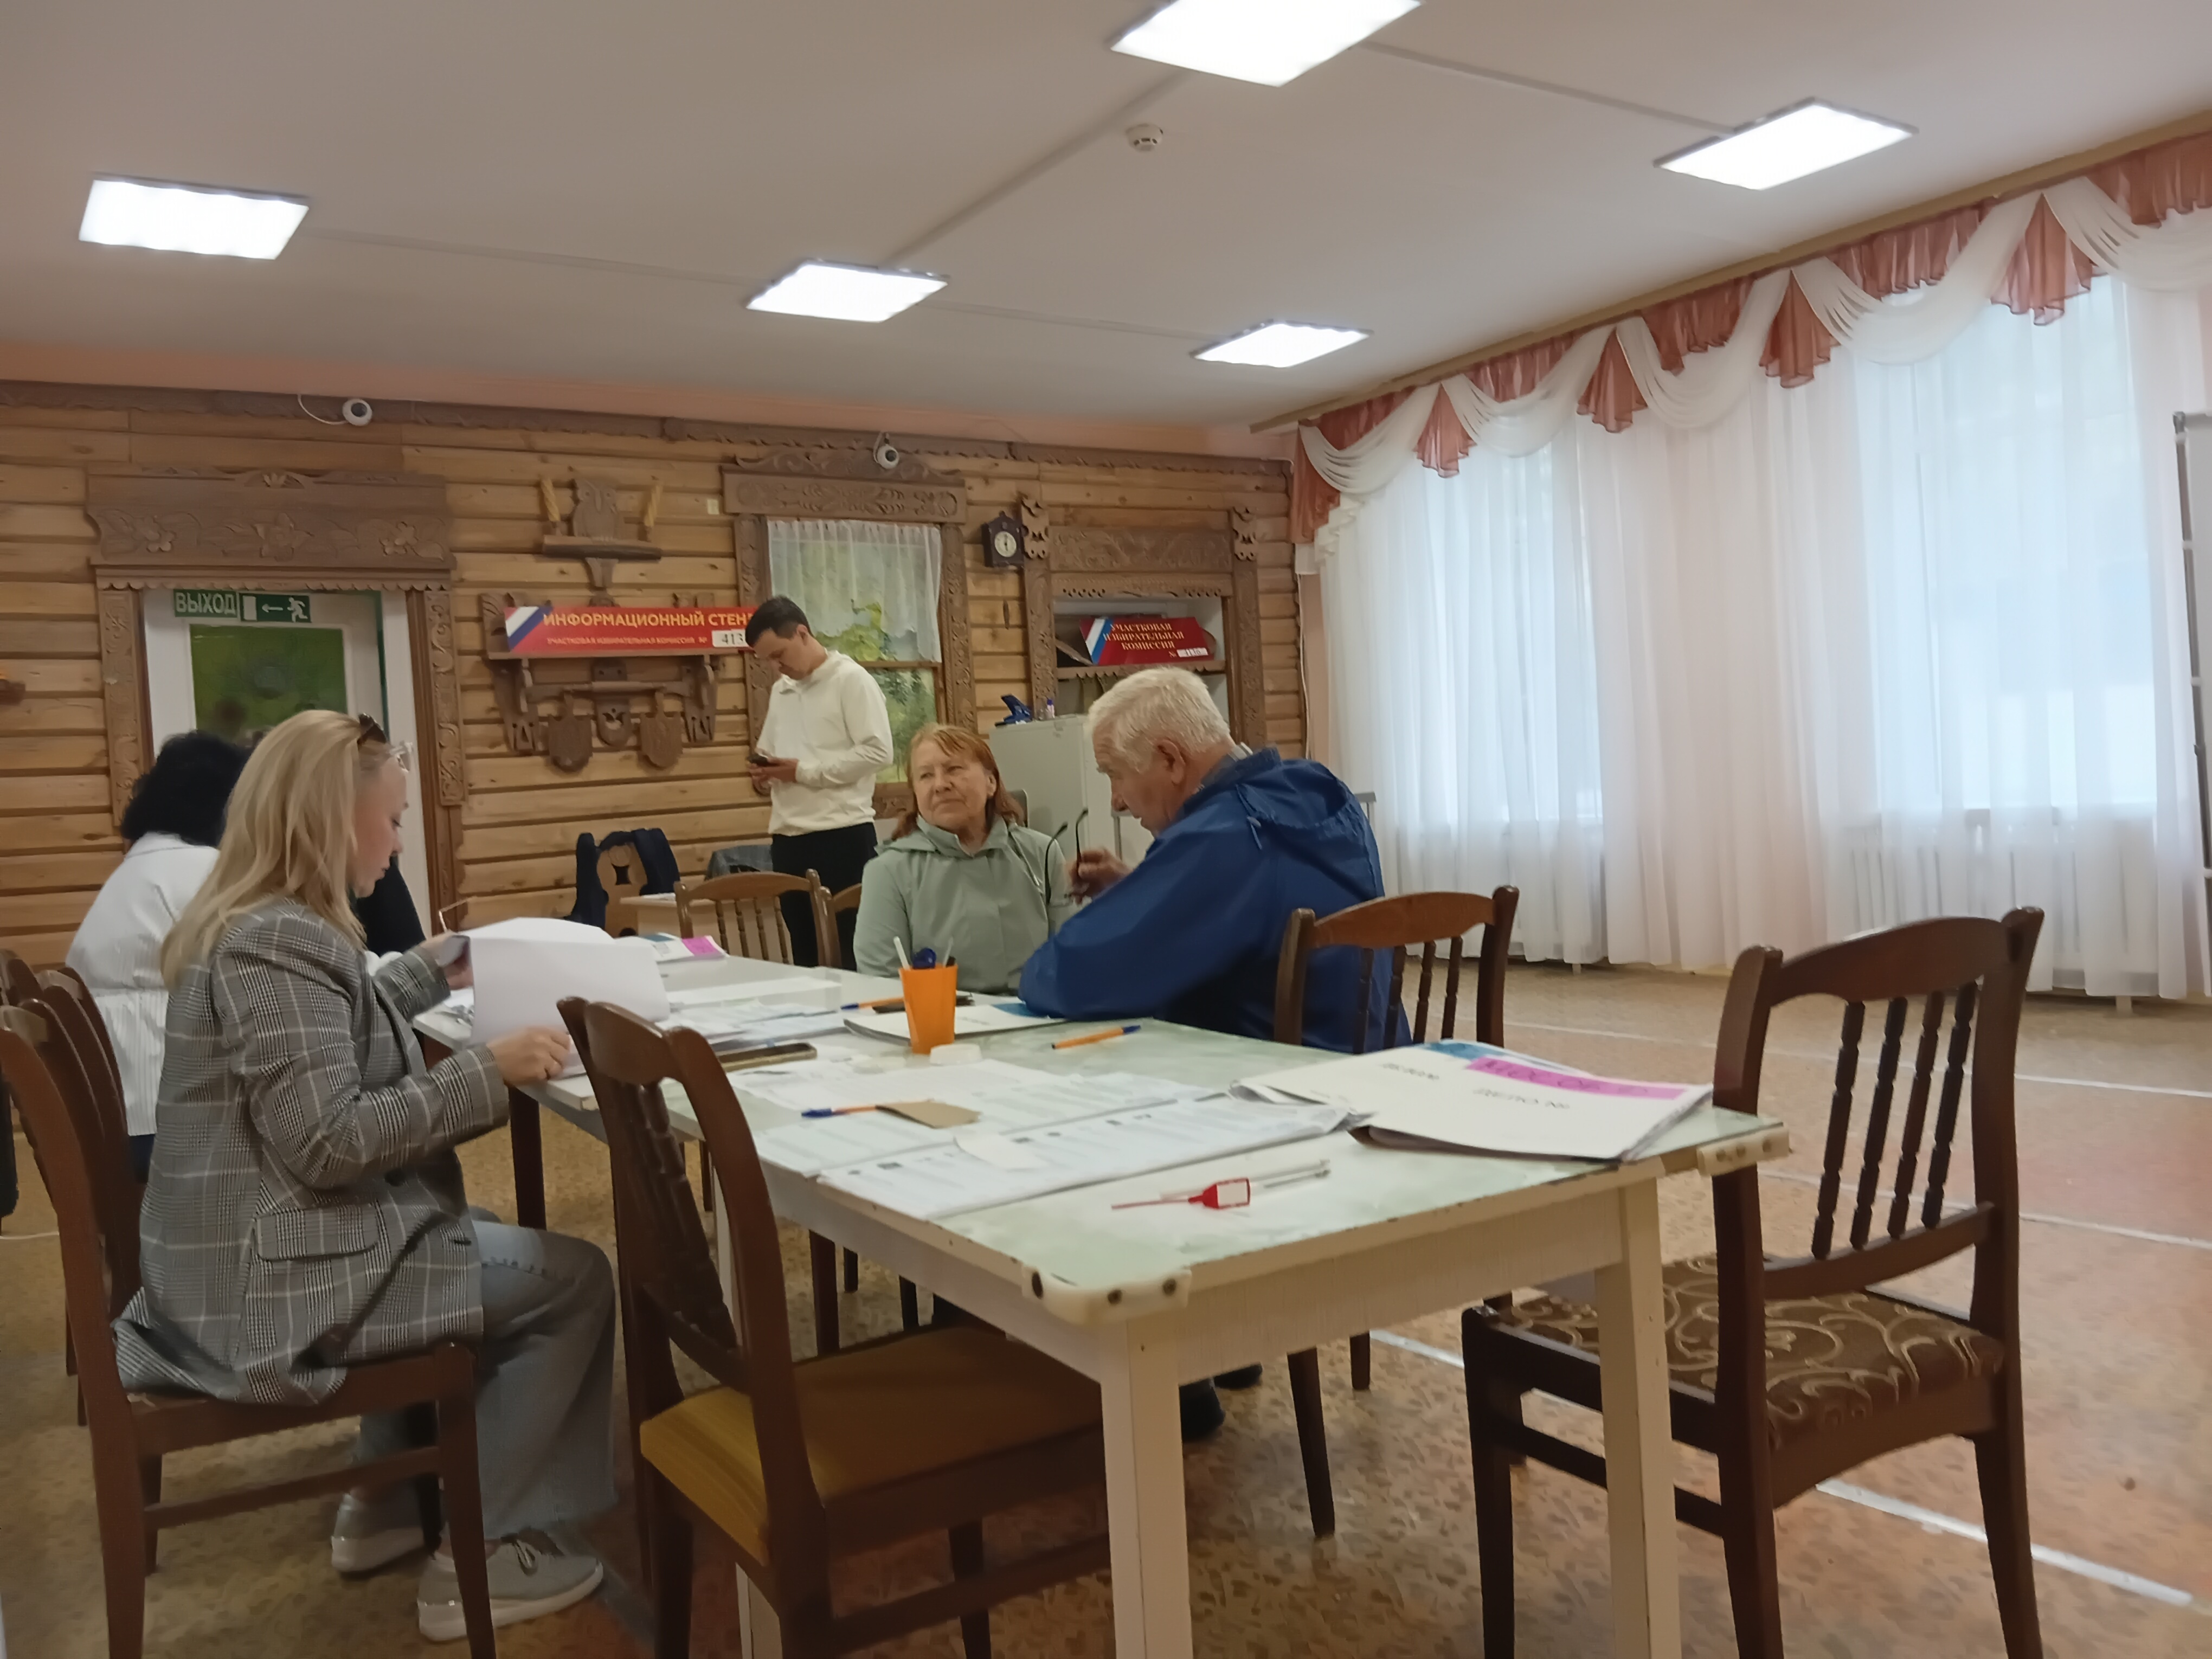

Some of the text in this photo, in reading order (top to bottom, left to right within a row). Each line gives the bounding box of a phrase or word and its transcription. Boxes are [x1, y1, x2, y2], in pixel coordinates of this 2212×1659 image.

[176, 592, 236, 615] ВЫХОД
[544, 610, 704, 627] ИНФОРМАЦИОННЫЙ
[1110, 623, 1172, 632] УЧАСТКОВАЯ
[1121, 641, 1175, 650] КОМИССИЯ
